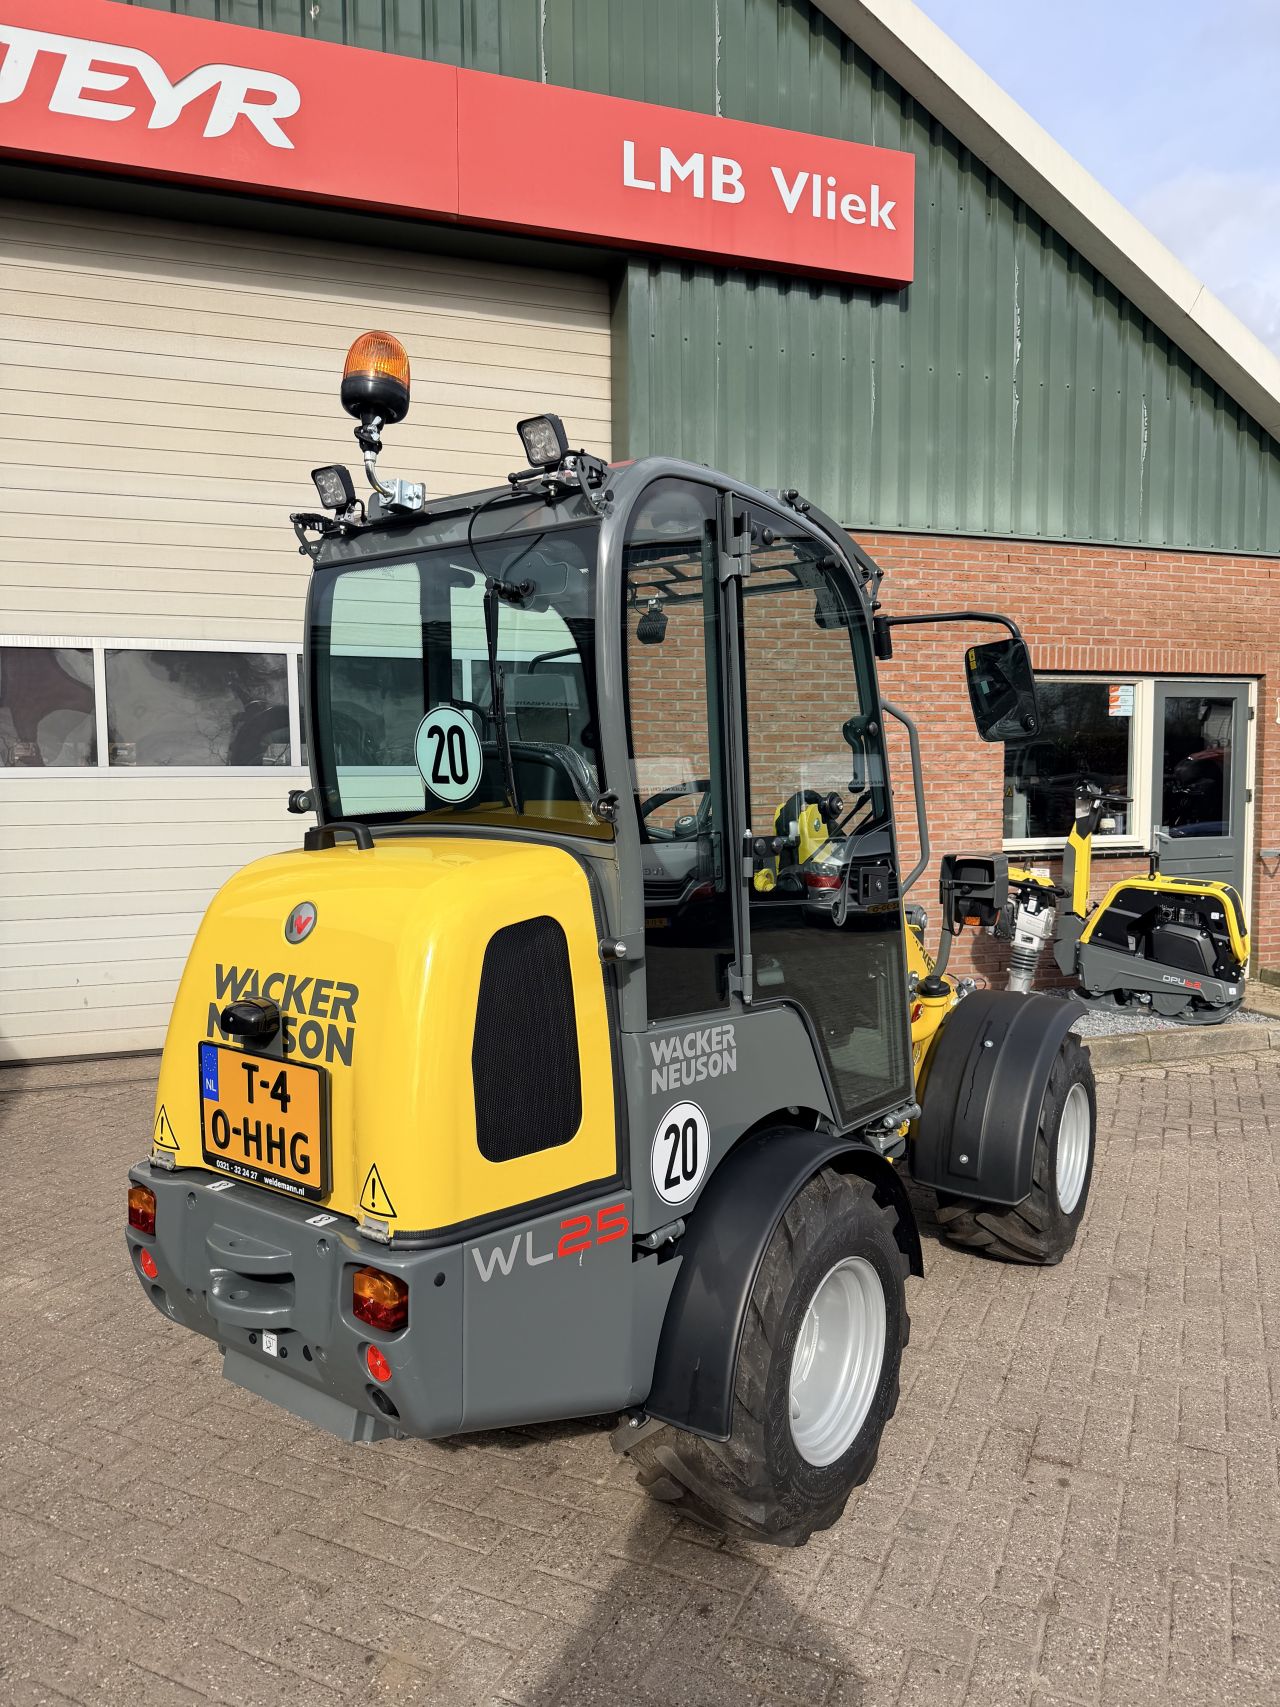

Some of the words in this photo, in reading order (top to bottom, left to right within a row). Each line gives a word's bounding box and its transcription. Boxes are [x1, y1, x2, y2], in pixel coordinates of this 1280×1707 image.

[623, 140, 745, 204] LMB
[771, 166, 897, 231] Vliek
[427, 724, 469, 785] 20
[215, 963, 360, 1023] WACKER
[206, 1001, 356, 1067] NSON
[650, 1024, 737, 1066] WACKER
[205, 1078, 217, 1092] NL
[241, 1061, 291, 1113] T-4
[651, 1048, 737, 1095] NEUSON
[216, 1159, 230, 1169] 0321
[234, 1165, 242, 1174] 32
[242, 1168, 250, 1178] 24
[250, 1171, 258, 1180] 27
[664, 1117, 698, 1190] 20
[263, 1176, 305, 1196] weidemann.nl
[471, 1203, 629, 1282] WL25
